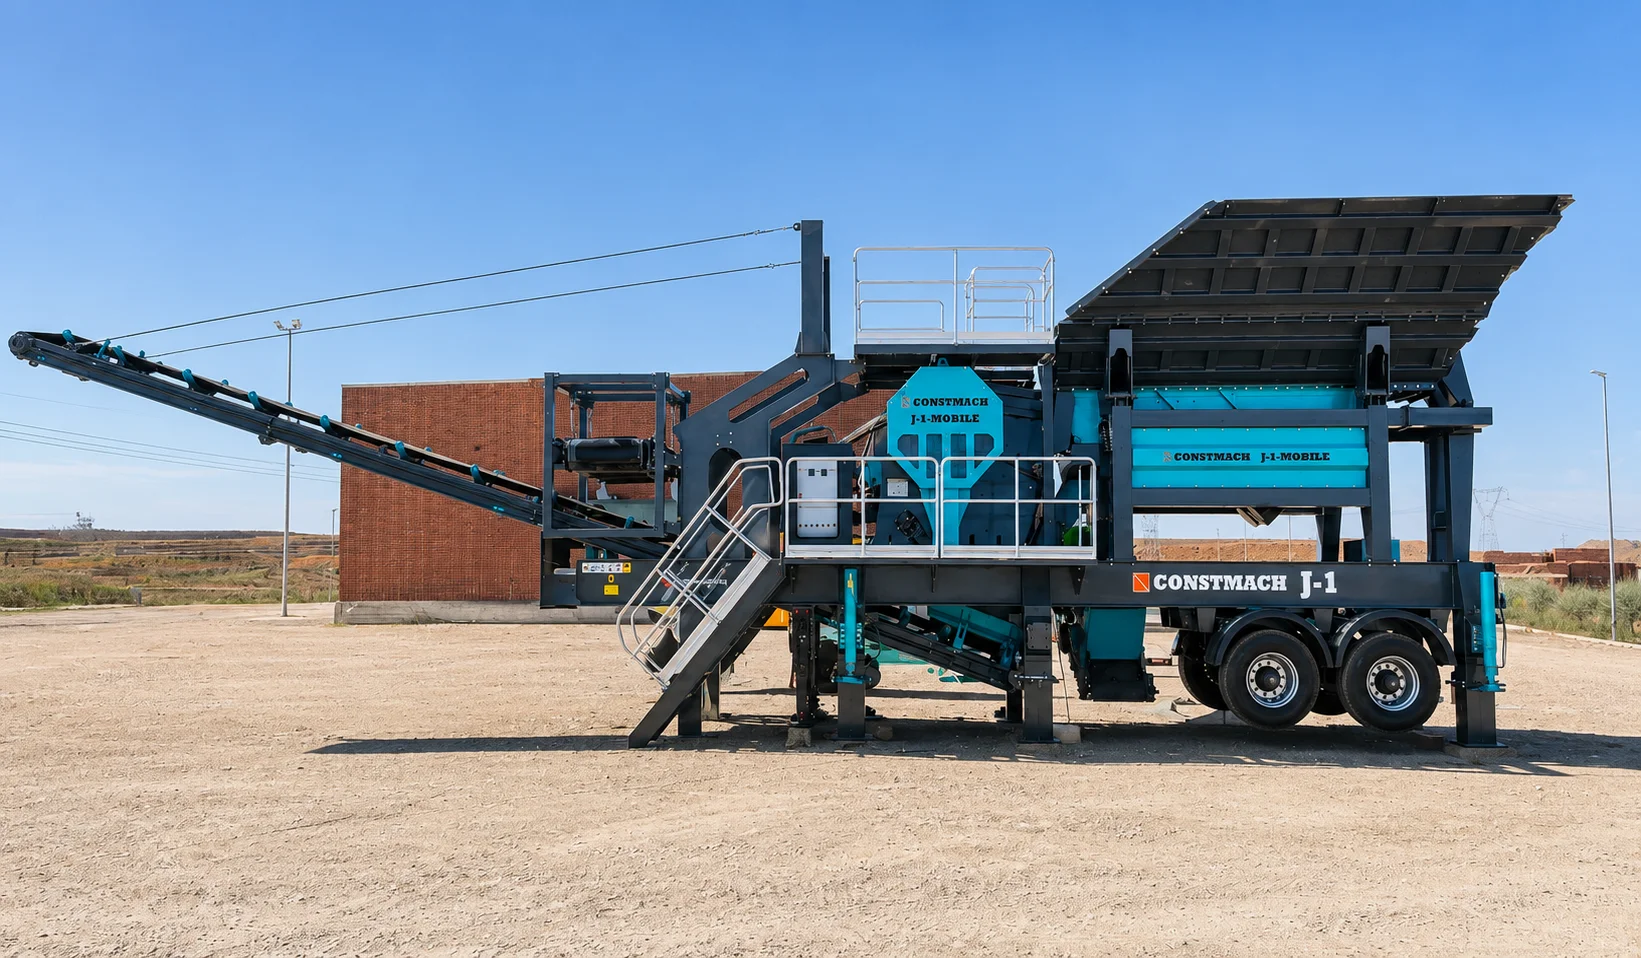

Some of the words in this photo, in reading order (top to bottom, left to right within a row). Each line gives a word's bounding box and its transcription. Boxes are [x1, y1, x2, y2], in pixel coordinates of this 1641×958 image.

[913, 397, 989, 407] CONSTMACH
[911, 414, 980, 425] J-1-MOBILE
[1174, 452, 1251, 462] CONSTMACH
[1261, 452, 1330, 463] J-1-MOBILE
[1153, 574, 1287, 591] CONSTMACH
[1300, 571, 1338, 599] J-1
